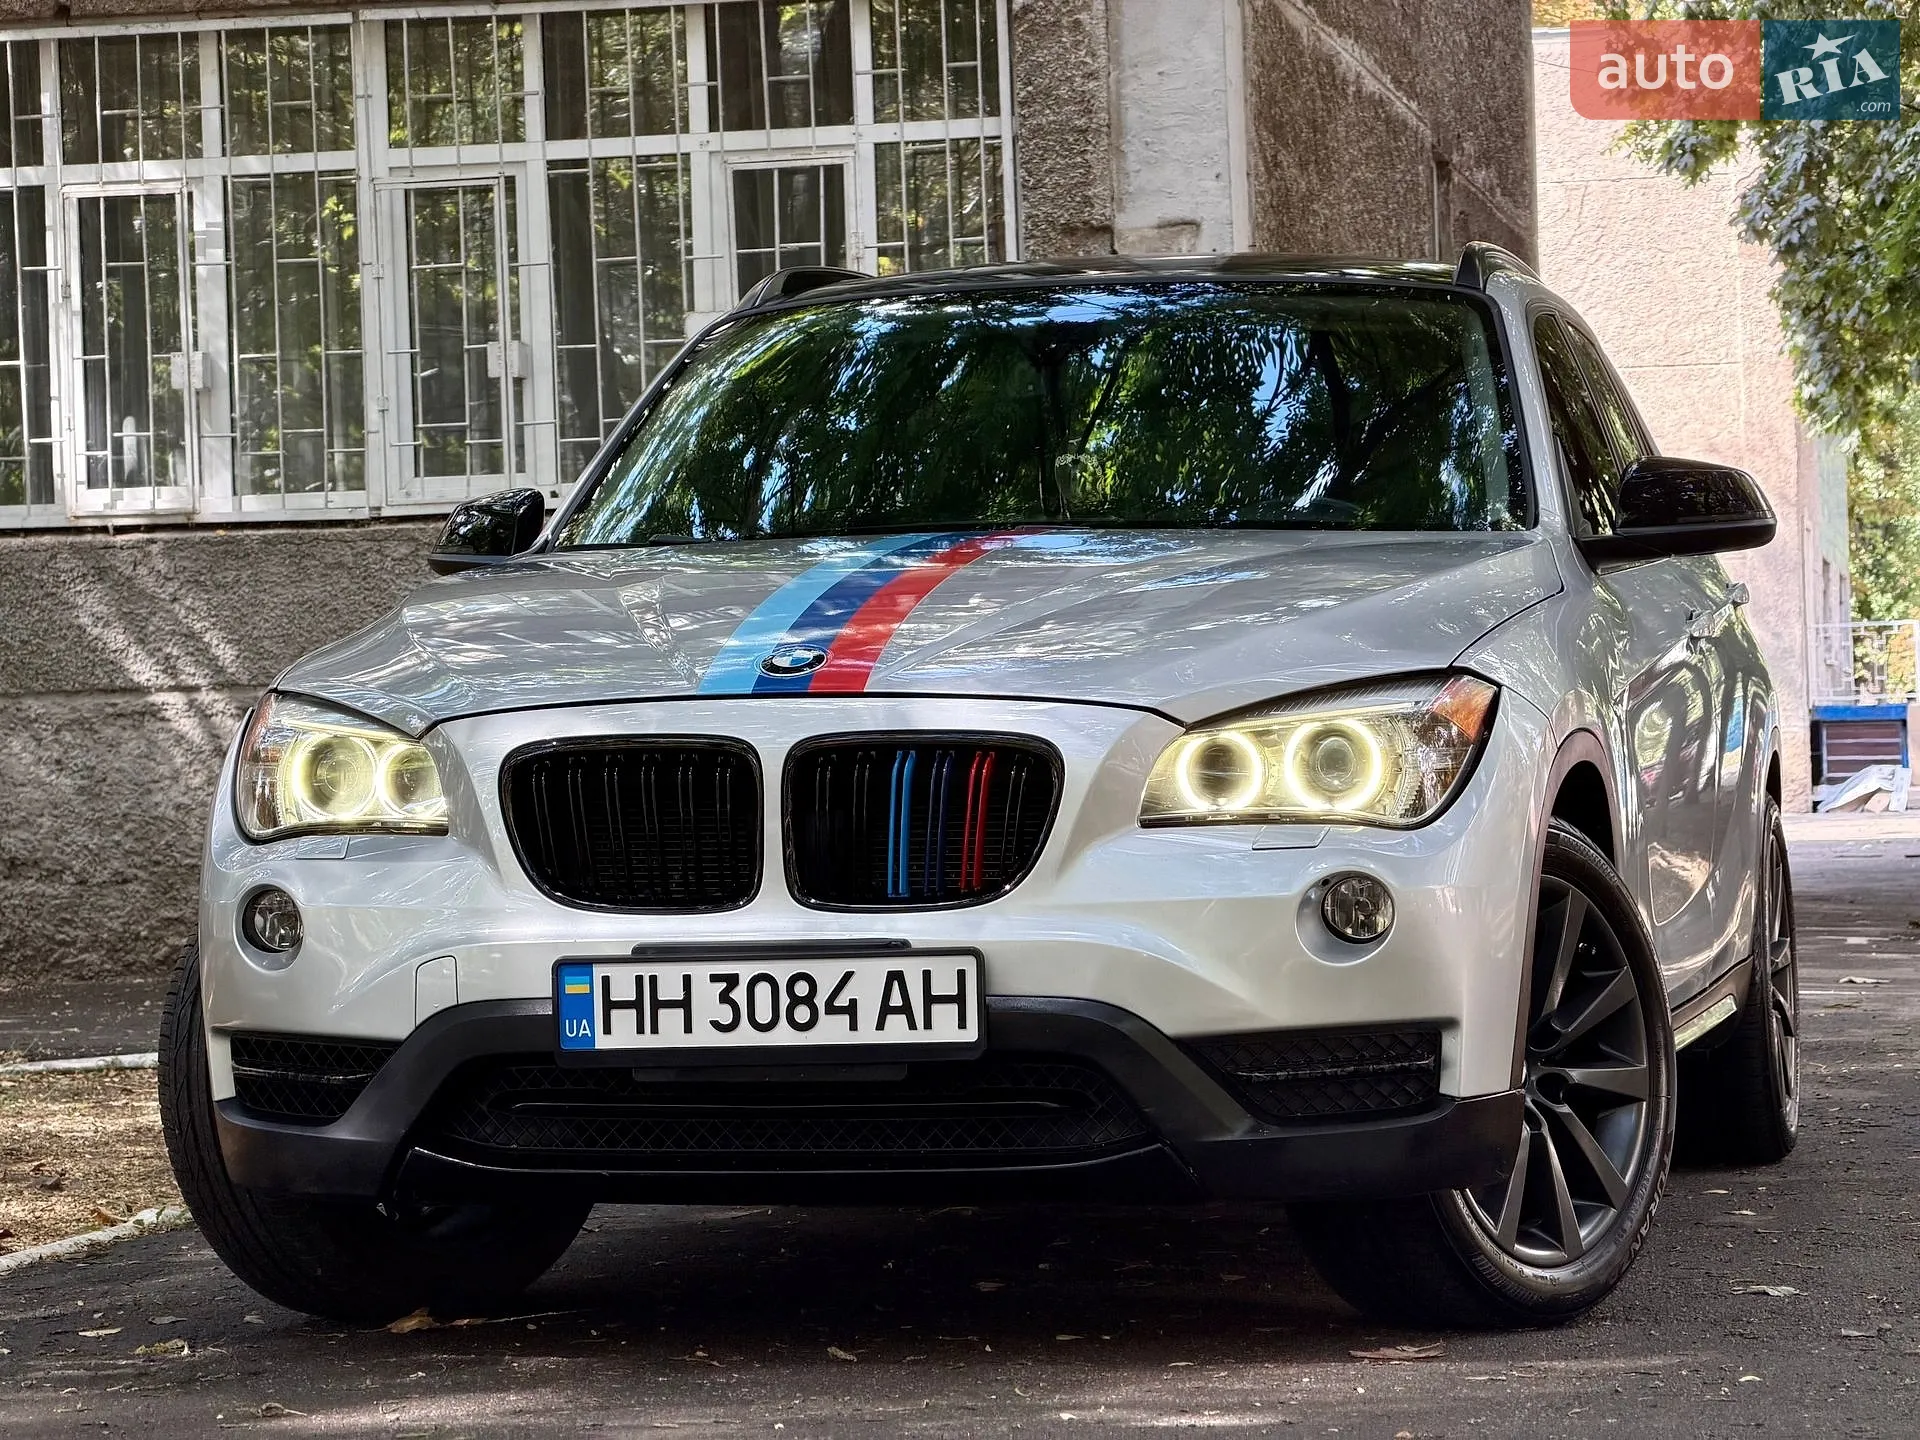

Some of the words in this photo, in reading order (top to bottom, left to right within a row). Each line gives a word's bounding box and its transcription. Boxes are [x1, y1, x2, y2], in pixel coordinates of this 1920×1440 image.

[600, 974, 693, 1035] HH
[708, 969, 859, 1033] 3084
[874, 968, 968, 1032] AH
[565, 1019, 592, 1038] UA
